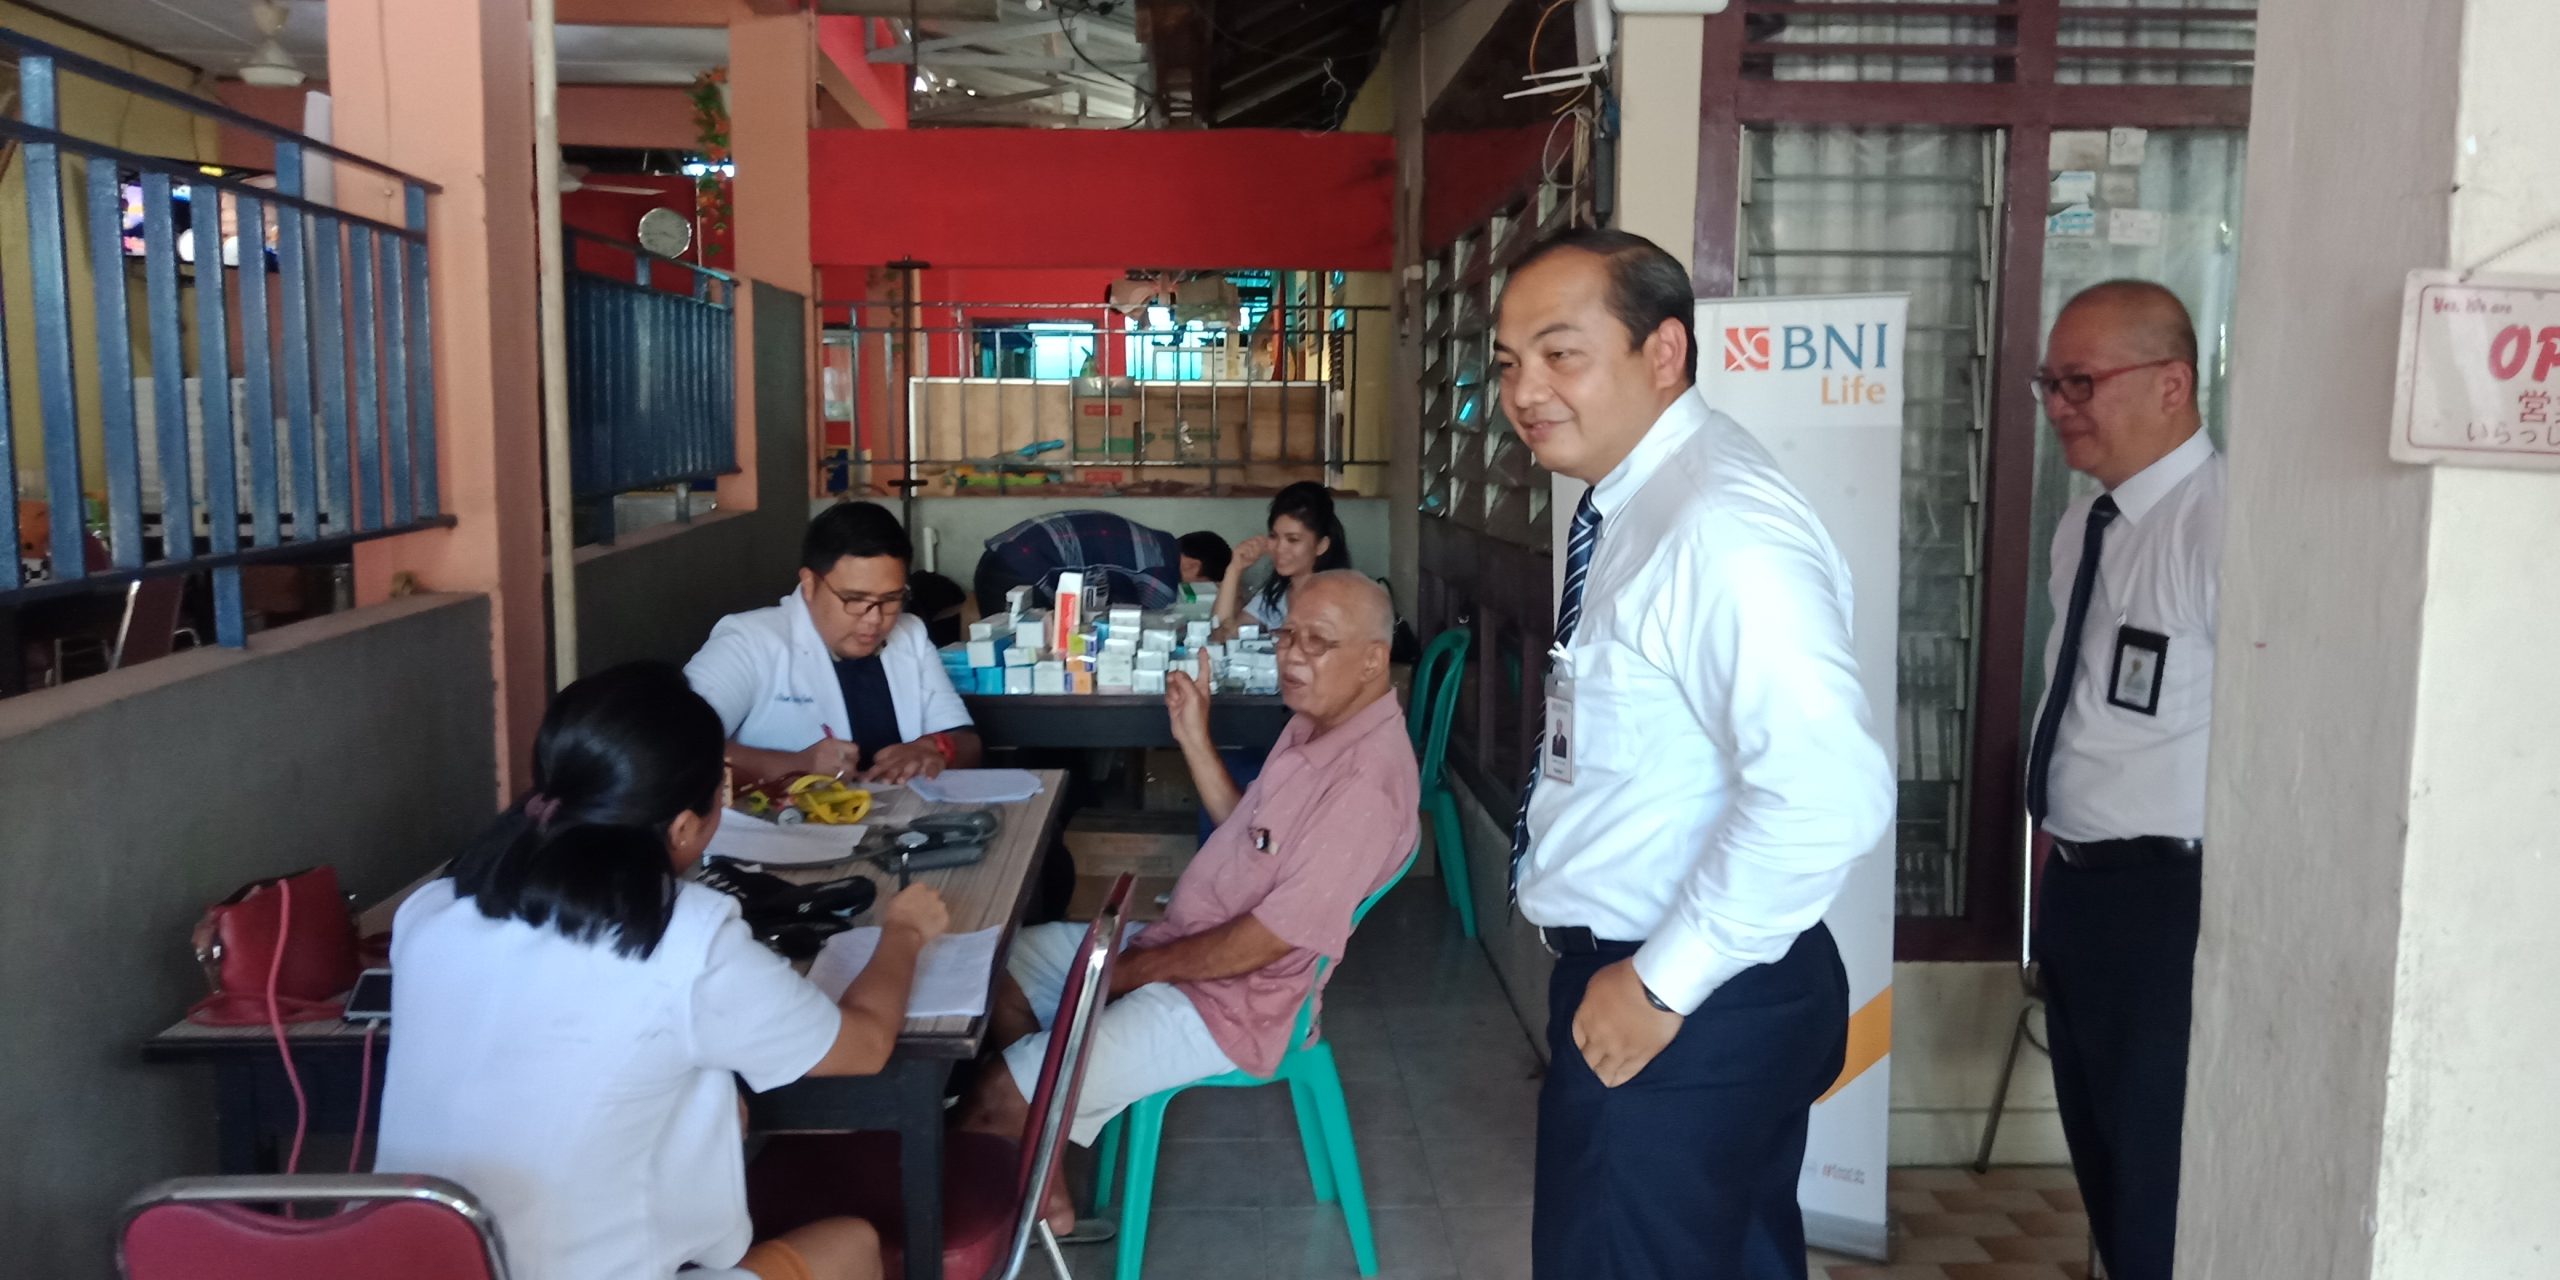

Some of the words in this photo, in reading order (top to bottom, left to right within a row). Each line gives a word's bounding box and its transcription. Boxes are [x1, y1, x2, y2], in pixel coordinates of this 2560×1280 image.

[2490, 304, 2511, 314] are
[1782, 322, 1888, 371] BNI
[1821, 374, 1886, 405] Life
